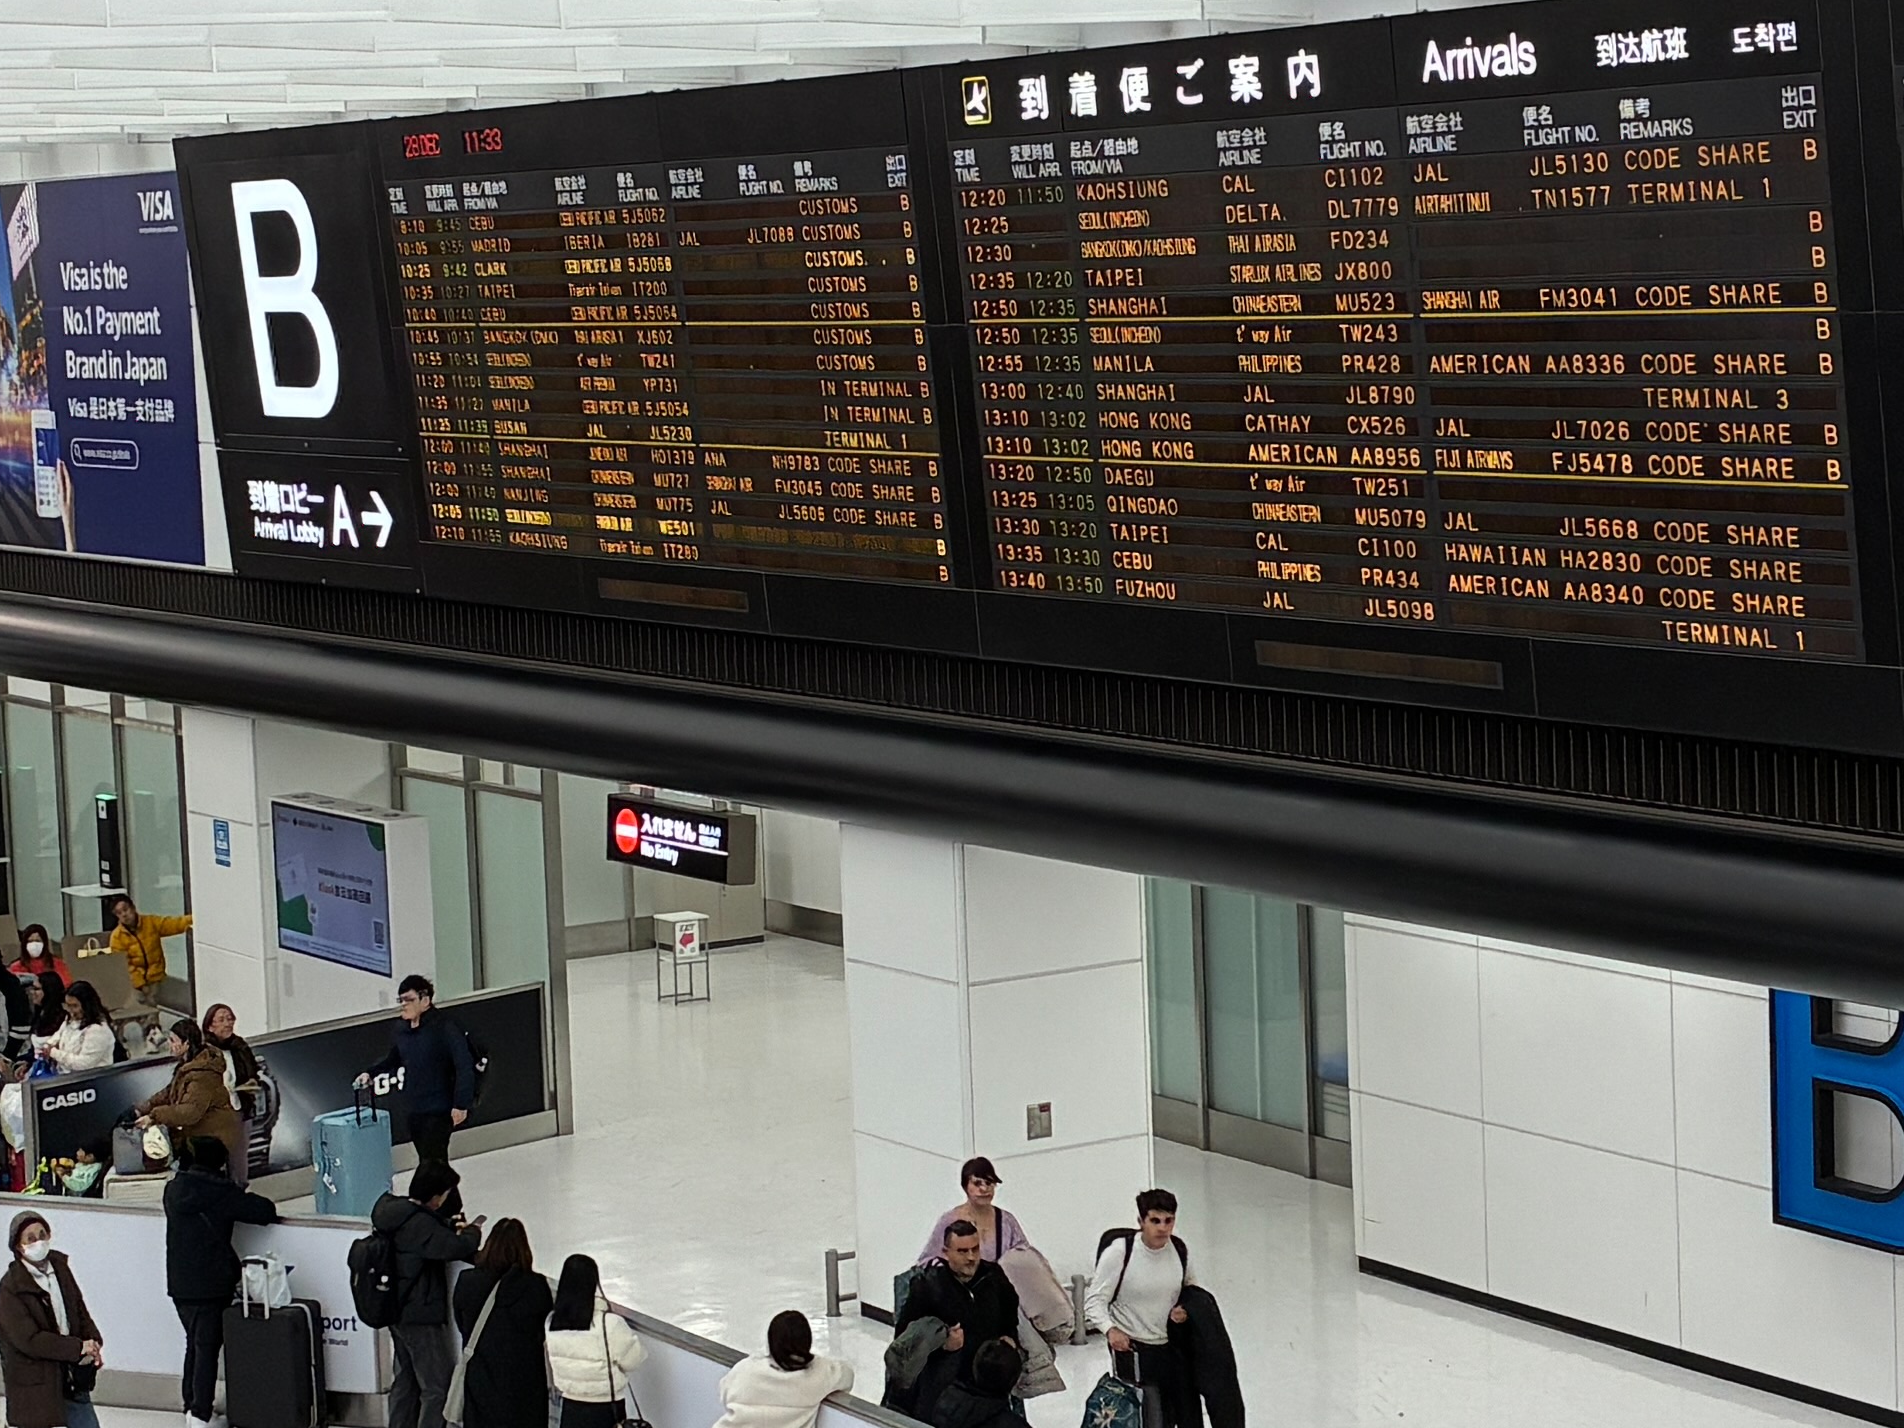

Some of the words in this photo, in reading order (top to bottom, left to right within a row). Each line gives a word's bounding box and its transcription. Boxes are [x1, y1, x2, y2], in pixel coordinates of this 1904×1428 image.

[1733, 21, 1798, 54] 도착편
[1423, 32, 1537, 83] Arrivals
[1018, 49, 1322, 121] 到着便ご案内
[137, 190, 174, 221] VISA
[799, 198, 858, 216] CUSTOMS
[900, 195, 909, 211] B
[60, 261, 89, 291] Visa
[90, 262, 102, 290] is
[103, 259, 128, 290] the
[232, 179, 339, 418] B
[63, 305, 92, 335] No.1
[96, 305, 161, 341] Payment
[65, 350, 107, 379] Brand
[109, 350, 122, 379] in
[124, 349, 167, 386] Japan
[978, 355, 1023, 372] 12:55
[1035, 355, 1081, 373] 12:35
[1094, 355, 1154, 372] MANILA
[1239, 354, 1302, 374] PHILIPPINES
[1341, 355, 1401, 374] PR428
[1430, 355, 1531, 374] AMERICAN
[1545, 354, 1625, 375] AA8336
[1641, 353, 1697, 374] CODE
[1714, 354, 1788, 375] SHARE
[1819, 355, 1833, 374] B
[68, 397, 88, 418] Visa
[254, 516, 288, 541] Arrival
[289, 519, 324, 548] Lobby
[333, 484, 359, 548] A
[655, 843, 679, 866] Entry
[42, 1089, 96, 1111] CASIO
[322, 1315, 357, 1338] port
